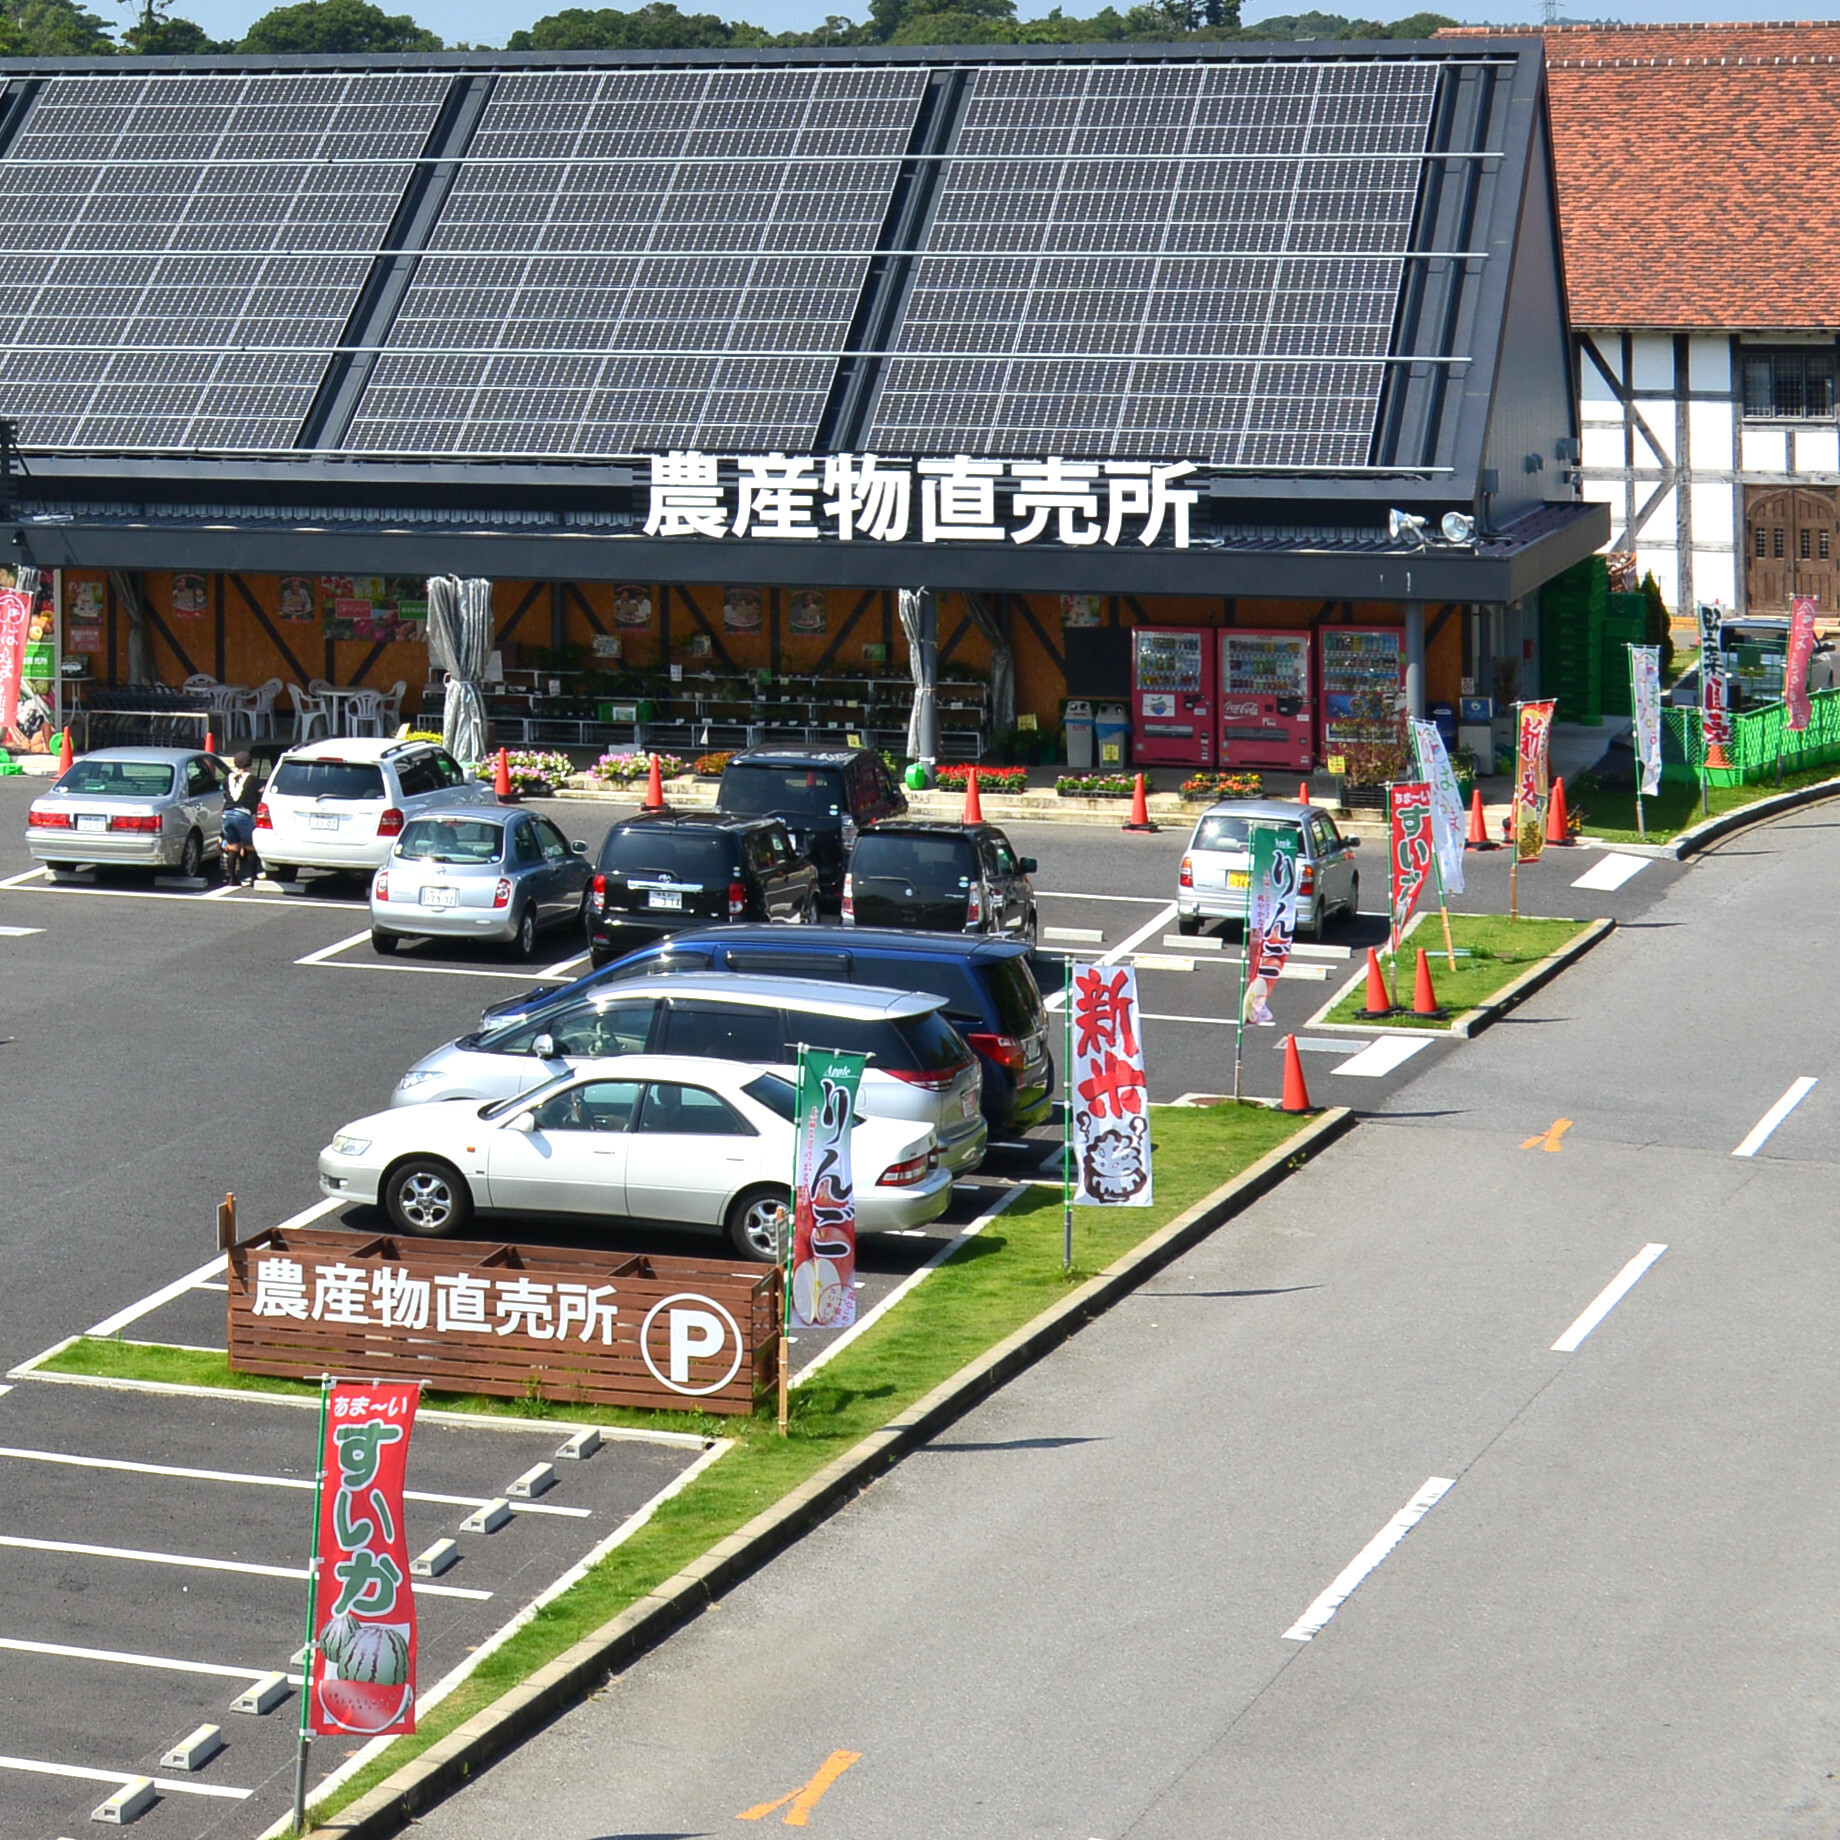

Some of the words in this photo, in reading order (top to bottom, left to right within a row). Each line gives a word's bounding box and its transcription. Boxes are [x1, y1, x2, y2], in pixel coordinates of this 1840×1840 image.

[643, 450, 1199, 549] 農産物直売所
[1258, 849, 1295, 979] りんご
[823, 1064, 852, 1078] Apple
[1075, 968, 1146, 1119] 新米
[810, 1078, 856, 1259] りんご
[251, 1257, 619, 1346] 農産物直売所
[670, 1308, 726, 1384] P
[331, 1418, 404, 1619] すいか
